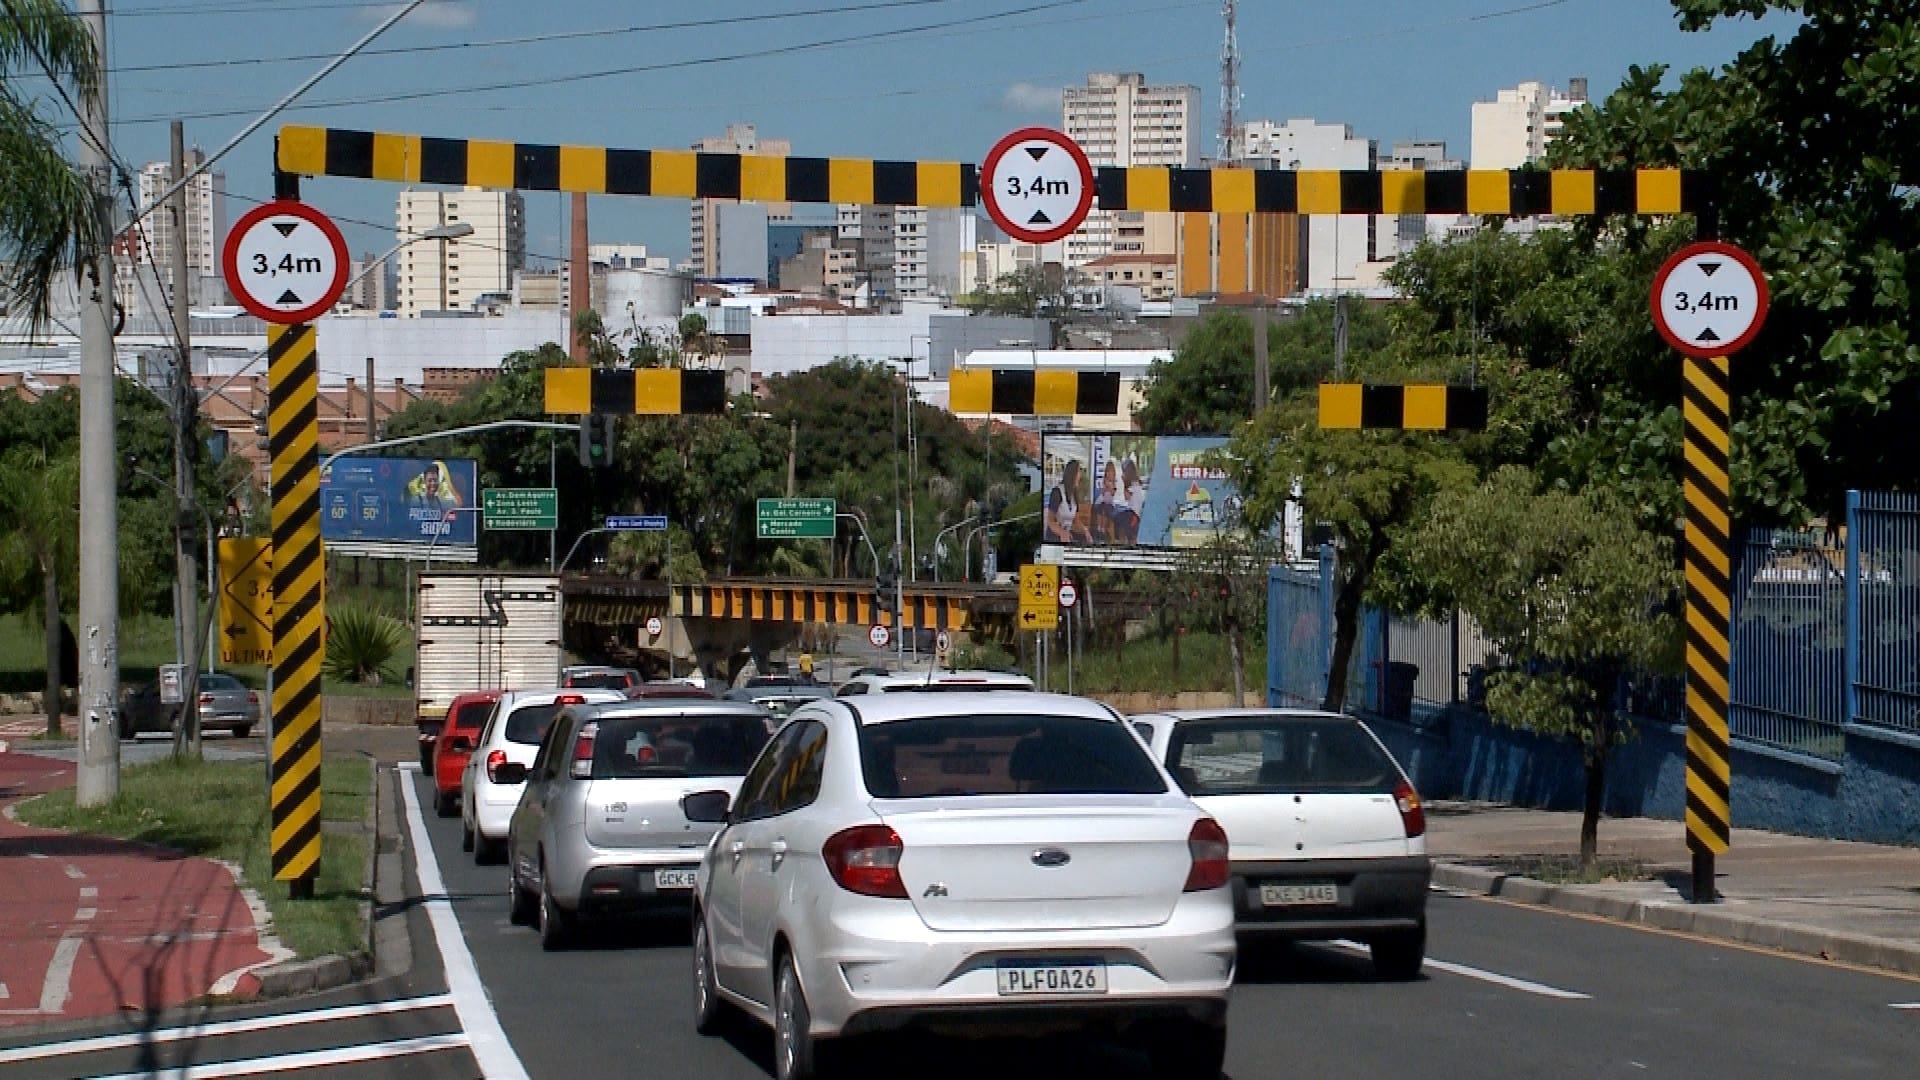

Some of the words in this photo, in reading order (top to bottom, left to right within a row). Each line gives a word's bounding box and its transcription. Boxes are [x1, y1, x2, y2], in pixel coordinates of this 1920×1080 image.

[1007, 175, 1069, 199] 3,4m
[252, 253, 322, 279] 3,4m
[1674, 291, 1738, 315] 3,4m
